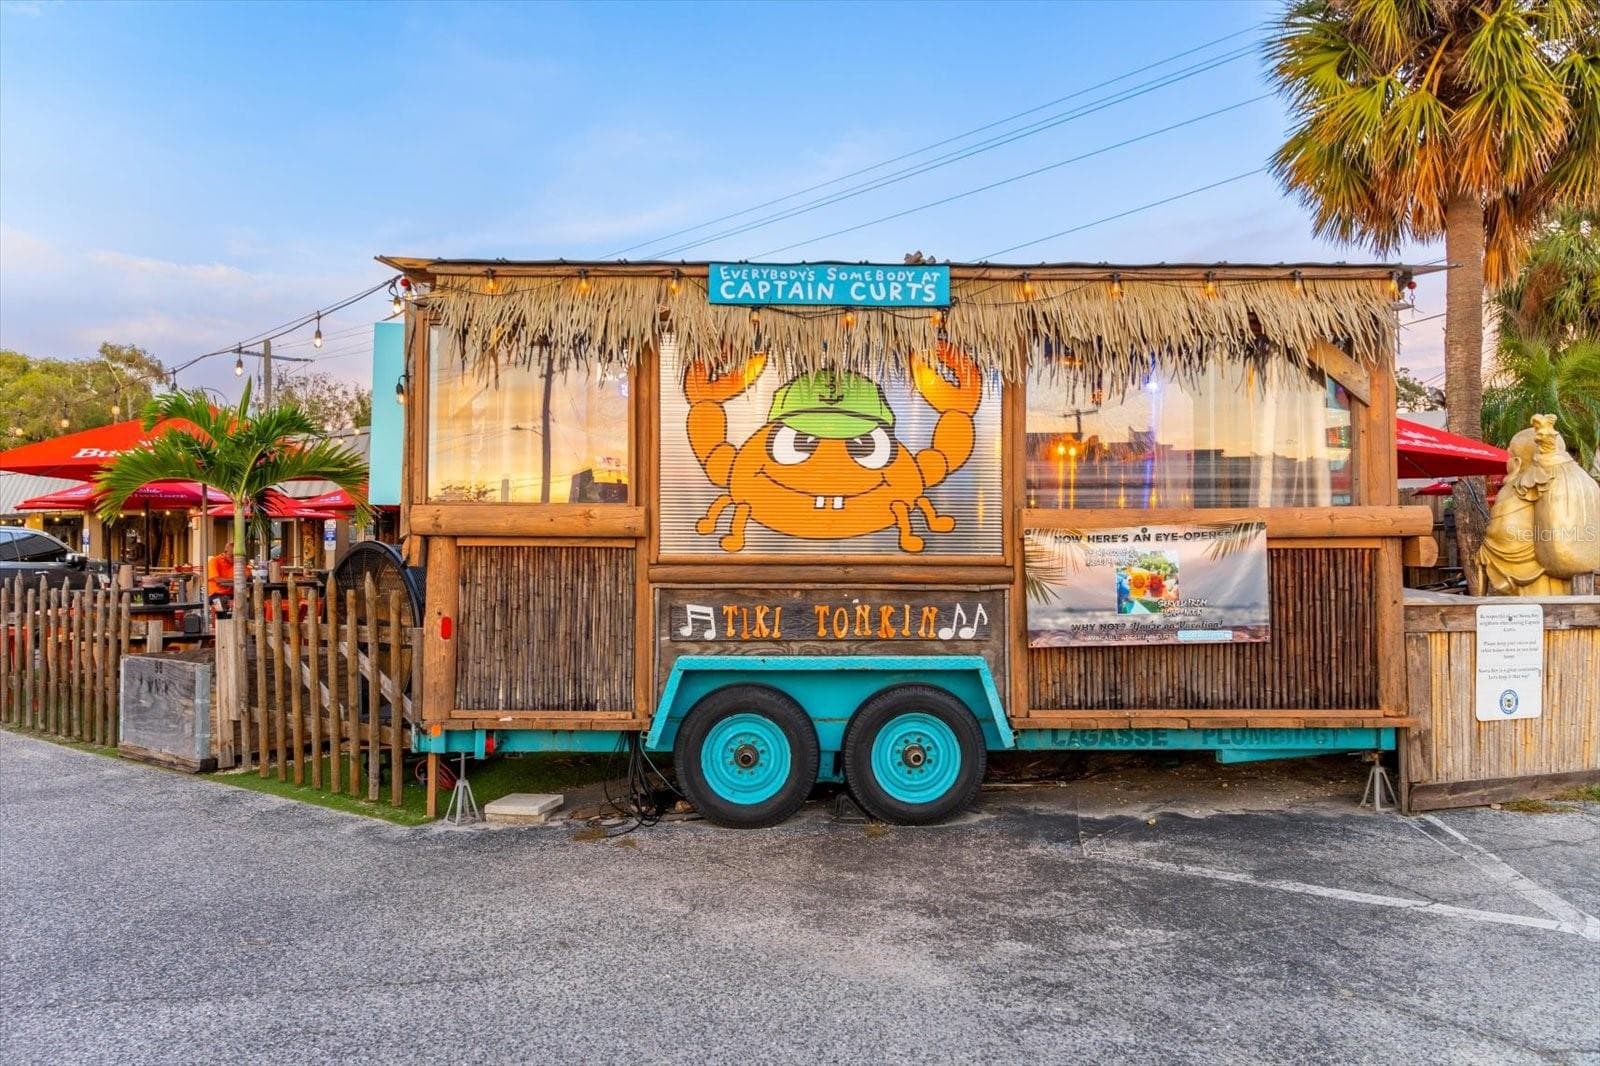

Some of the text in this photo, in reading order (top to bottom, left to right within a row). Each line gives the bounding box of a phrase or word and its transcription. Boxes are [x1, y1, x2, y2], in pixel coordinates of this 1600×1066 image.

[720, 266, 940, 282] EVERYBODY'S SOMEBODY AT
[720, 280, 834, 300] CAPTAIN
[1087, 533, 1129, 543] HERE'S
[1133, 533, 1151, 543] AN
[722, 604, 939, 640] TIKI TONKIN
[1071, 623, 1096, 632] WHY
[1099, 623, 1127, 631] NOT?
[1051, 729, 1169, 747] LAGASSE
